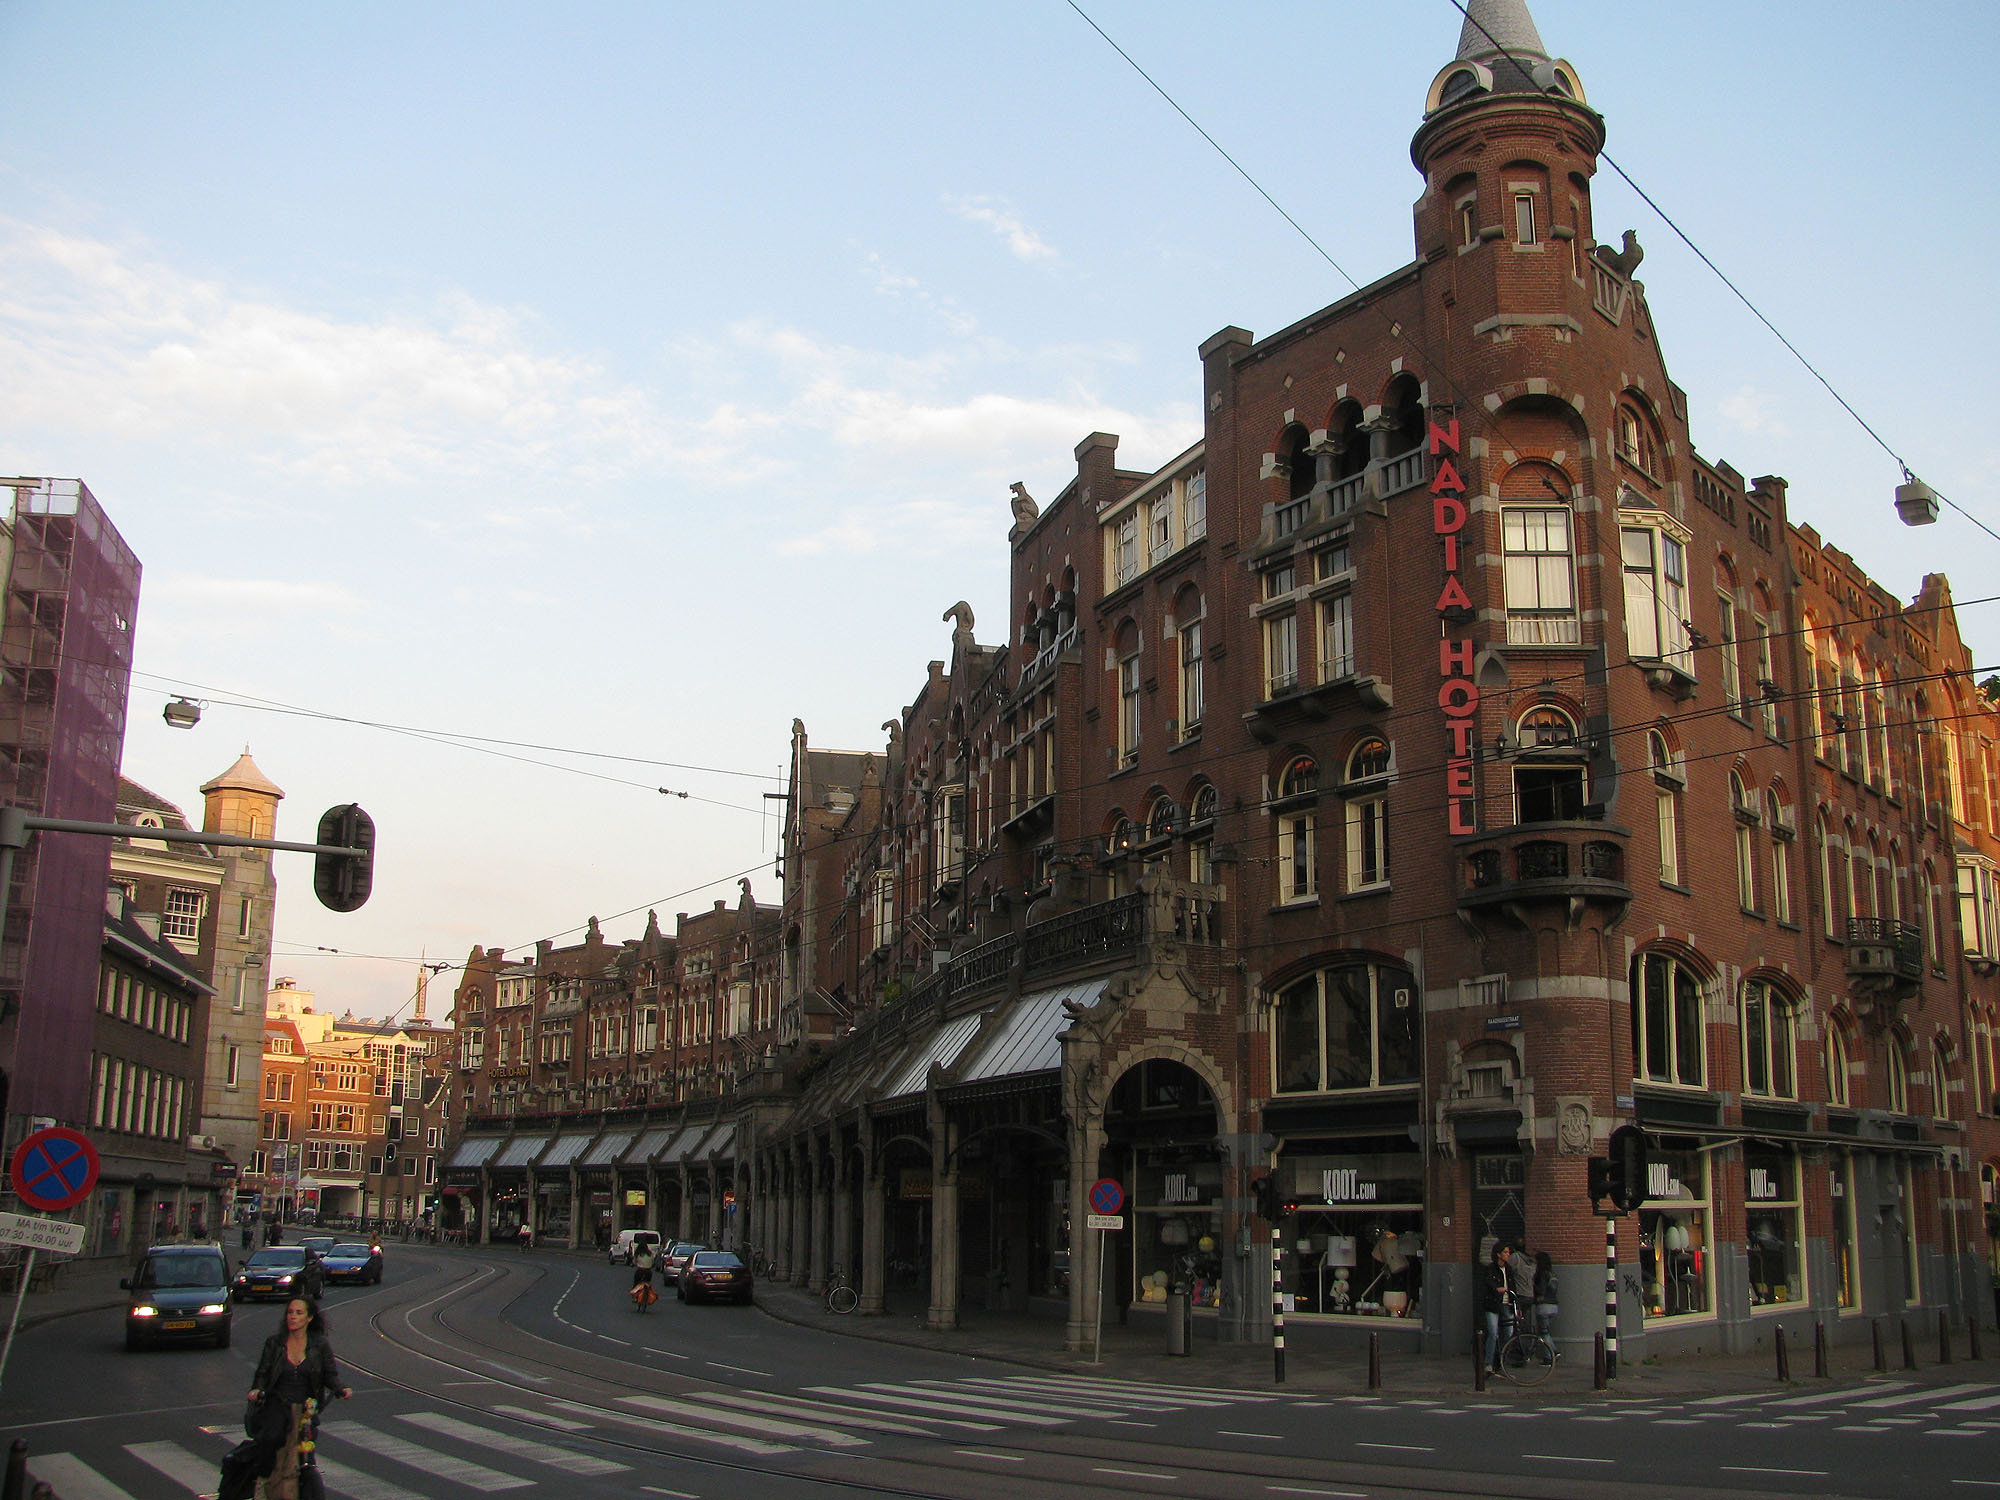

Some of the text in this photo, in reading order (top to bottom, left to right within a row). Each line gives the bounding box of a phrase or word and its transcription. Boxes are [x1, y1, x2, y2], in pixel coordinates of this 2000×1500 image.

[1428, 420, 1480, 836] NADIA HOTEL
[487, 1067, 507, 1078] HOTEL
[1323, 1169, 1377, 1200] KOOT.COM
[16, 1218, 31, 1229] MA
[50, 1222, 71, 1235] VRIJ
[58, 1240, 74, 1248] uur
